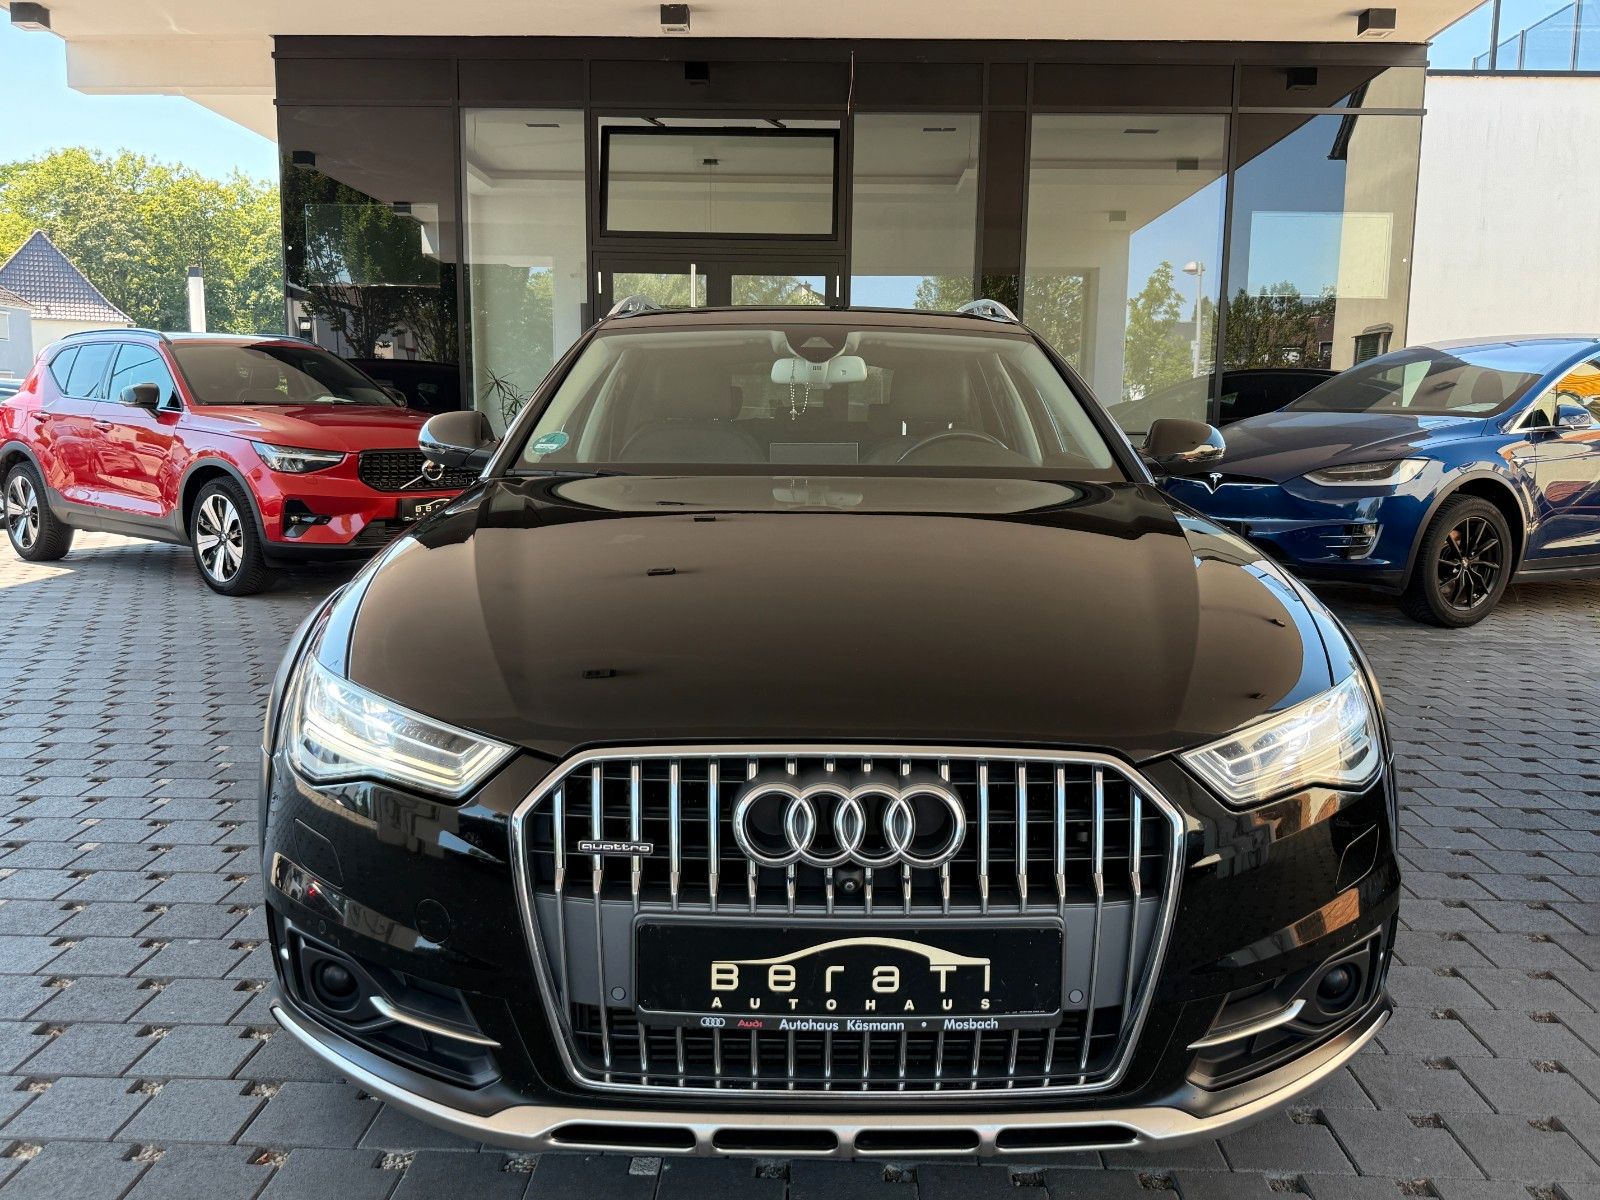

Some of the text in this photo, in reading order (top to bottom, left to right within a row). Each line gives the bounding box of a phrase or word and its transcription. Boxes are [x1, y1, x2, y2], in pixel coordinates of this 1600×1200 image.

[581, 843, 650, 852] quattro
[711, 996, 991, 1011] AUTOHAUS
[737, 1019, 763, 1028] Audi
[779, 1017, 999, 1031] Autohaus Käsmann Mosbach
